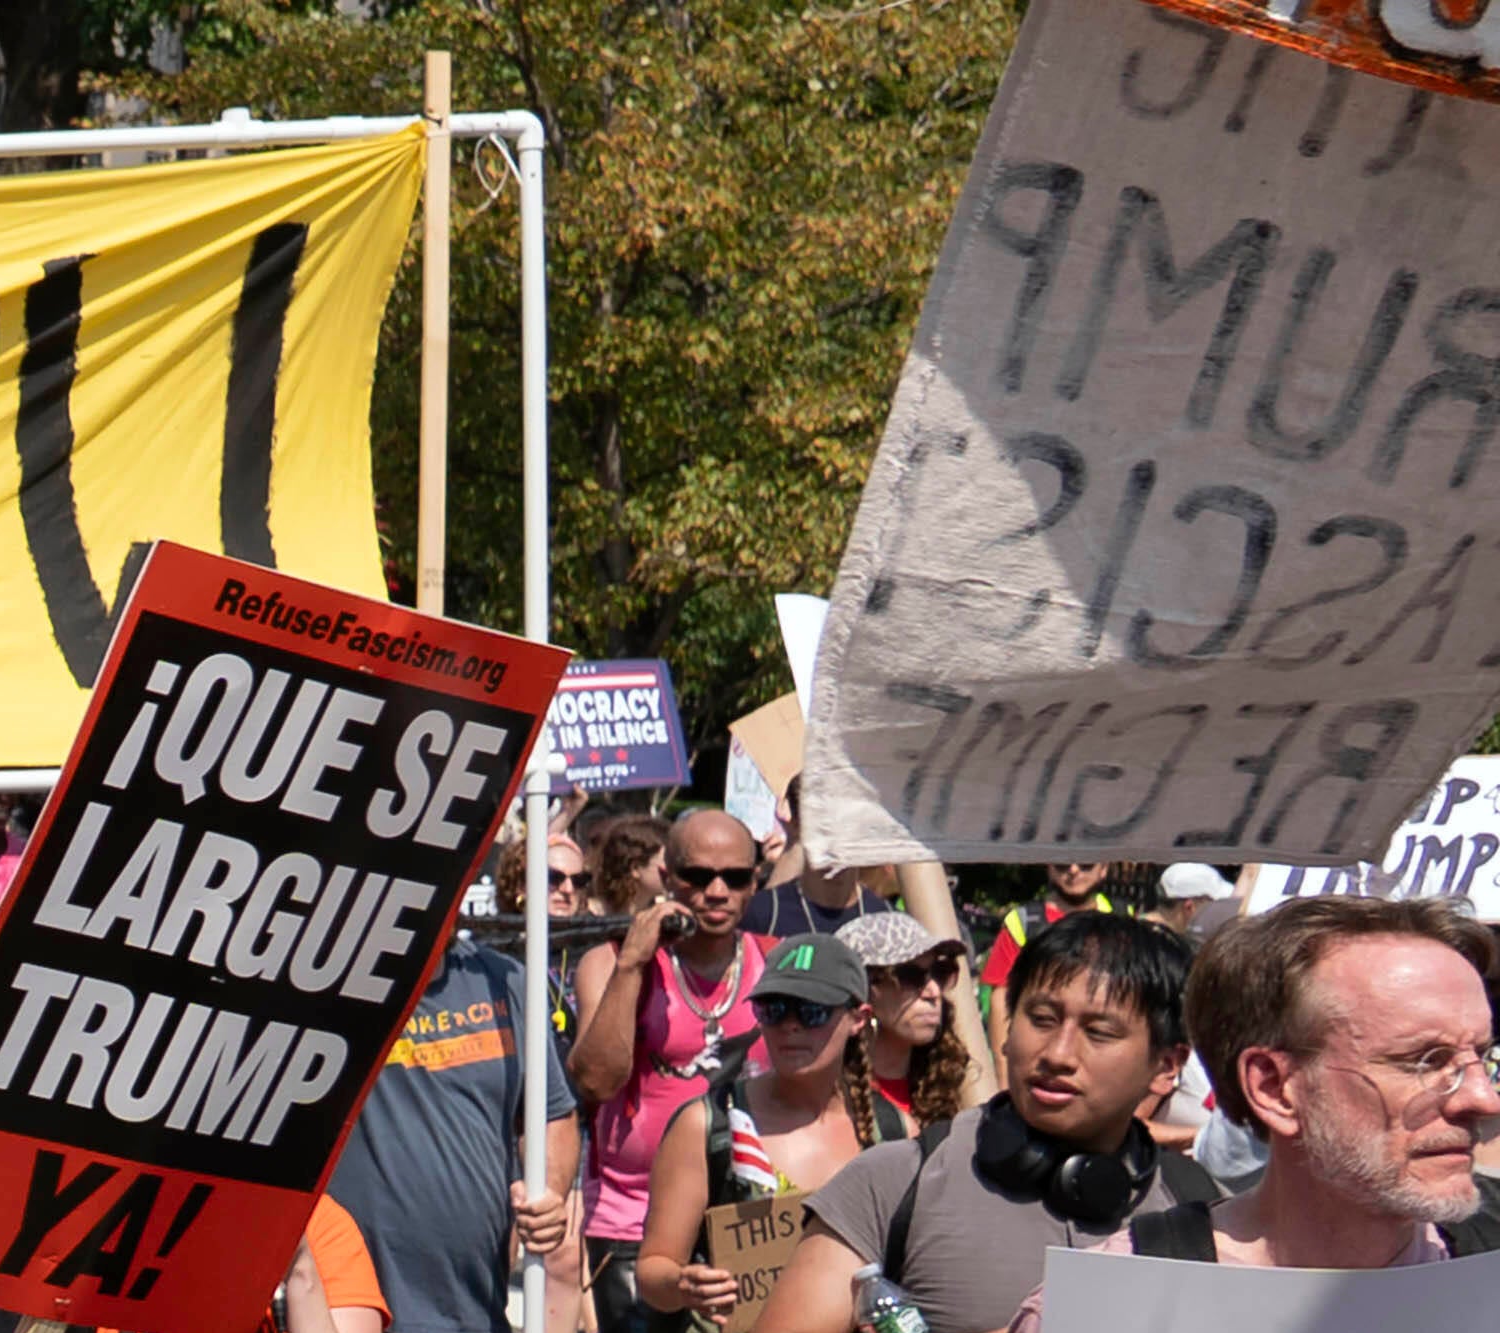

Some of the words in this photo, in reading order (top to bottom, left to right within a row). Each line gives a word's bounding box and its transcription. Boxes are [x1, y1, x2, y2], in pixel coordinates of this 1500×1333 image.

[215, 579, 507, 694] RefuseFascism.org
[547, 688, 660, 725] MOCRACY
[560, 725, 582, 749] IN
[586, 720, 669, 747] SILENCE
[104, 653, 385, 821] ¡QUE
[367, 708, 511, 851] SE
[34, 802, 437, 1004] LARGUE
[724, 1211, 794, 1250] THIS
